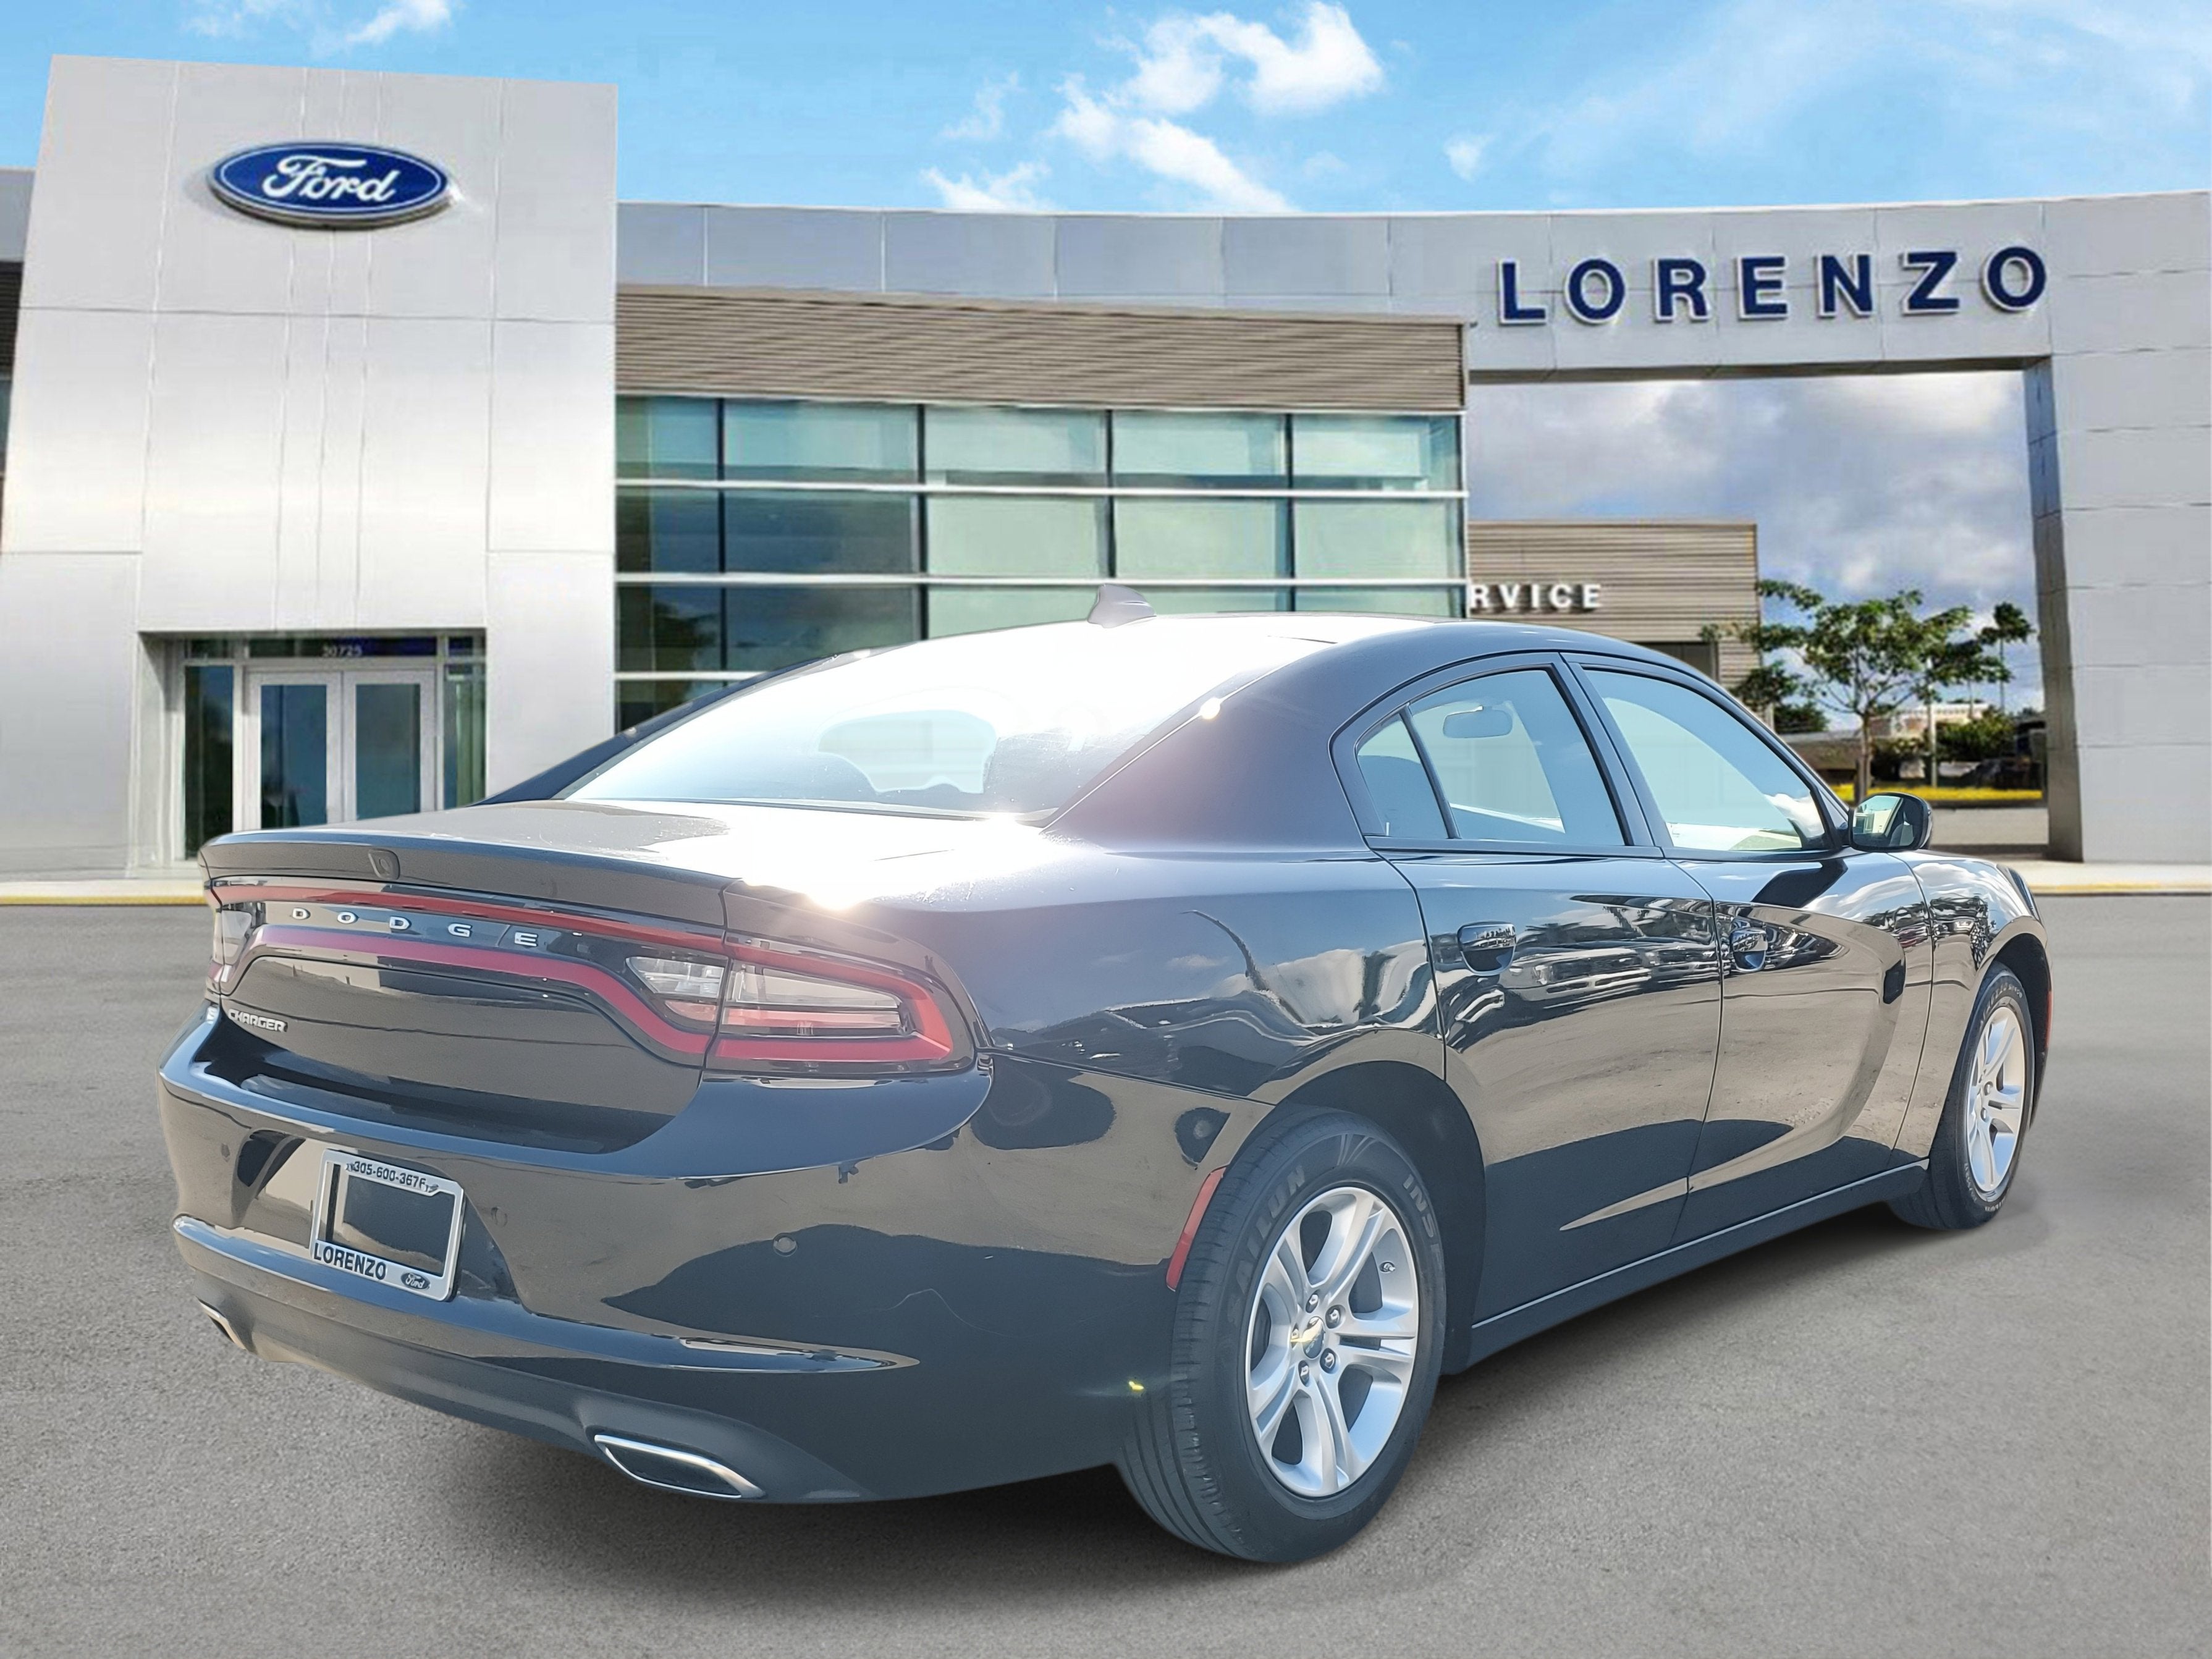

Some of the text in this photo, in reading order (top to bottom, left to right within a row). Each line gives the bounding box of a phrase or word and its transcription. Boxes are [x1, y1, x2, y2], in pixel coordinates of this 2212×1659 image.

[263, 154, 400, 202] Ford
[1498, 245, 2047, 324] LORENZO
[292, 907, 538, 947] DODGE
[228, 1008, 287, 1032] CHARGER
[314, 1243, 387, 1280] LORENZO
